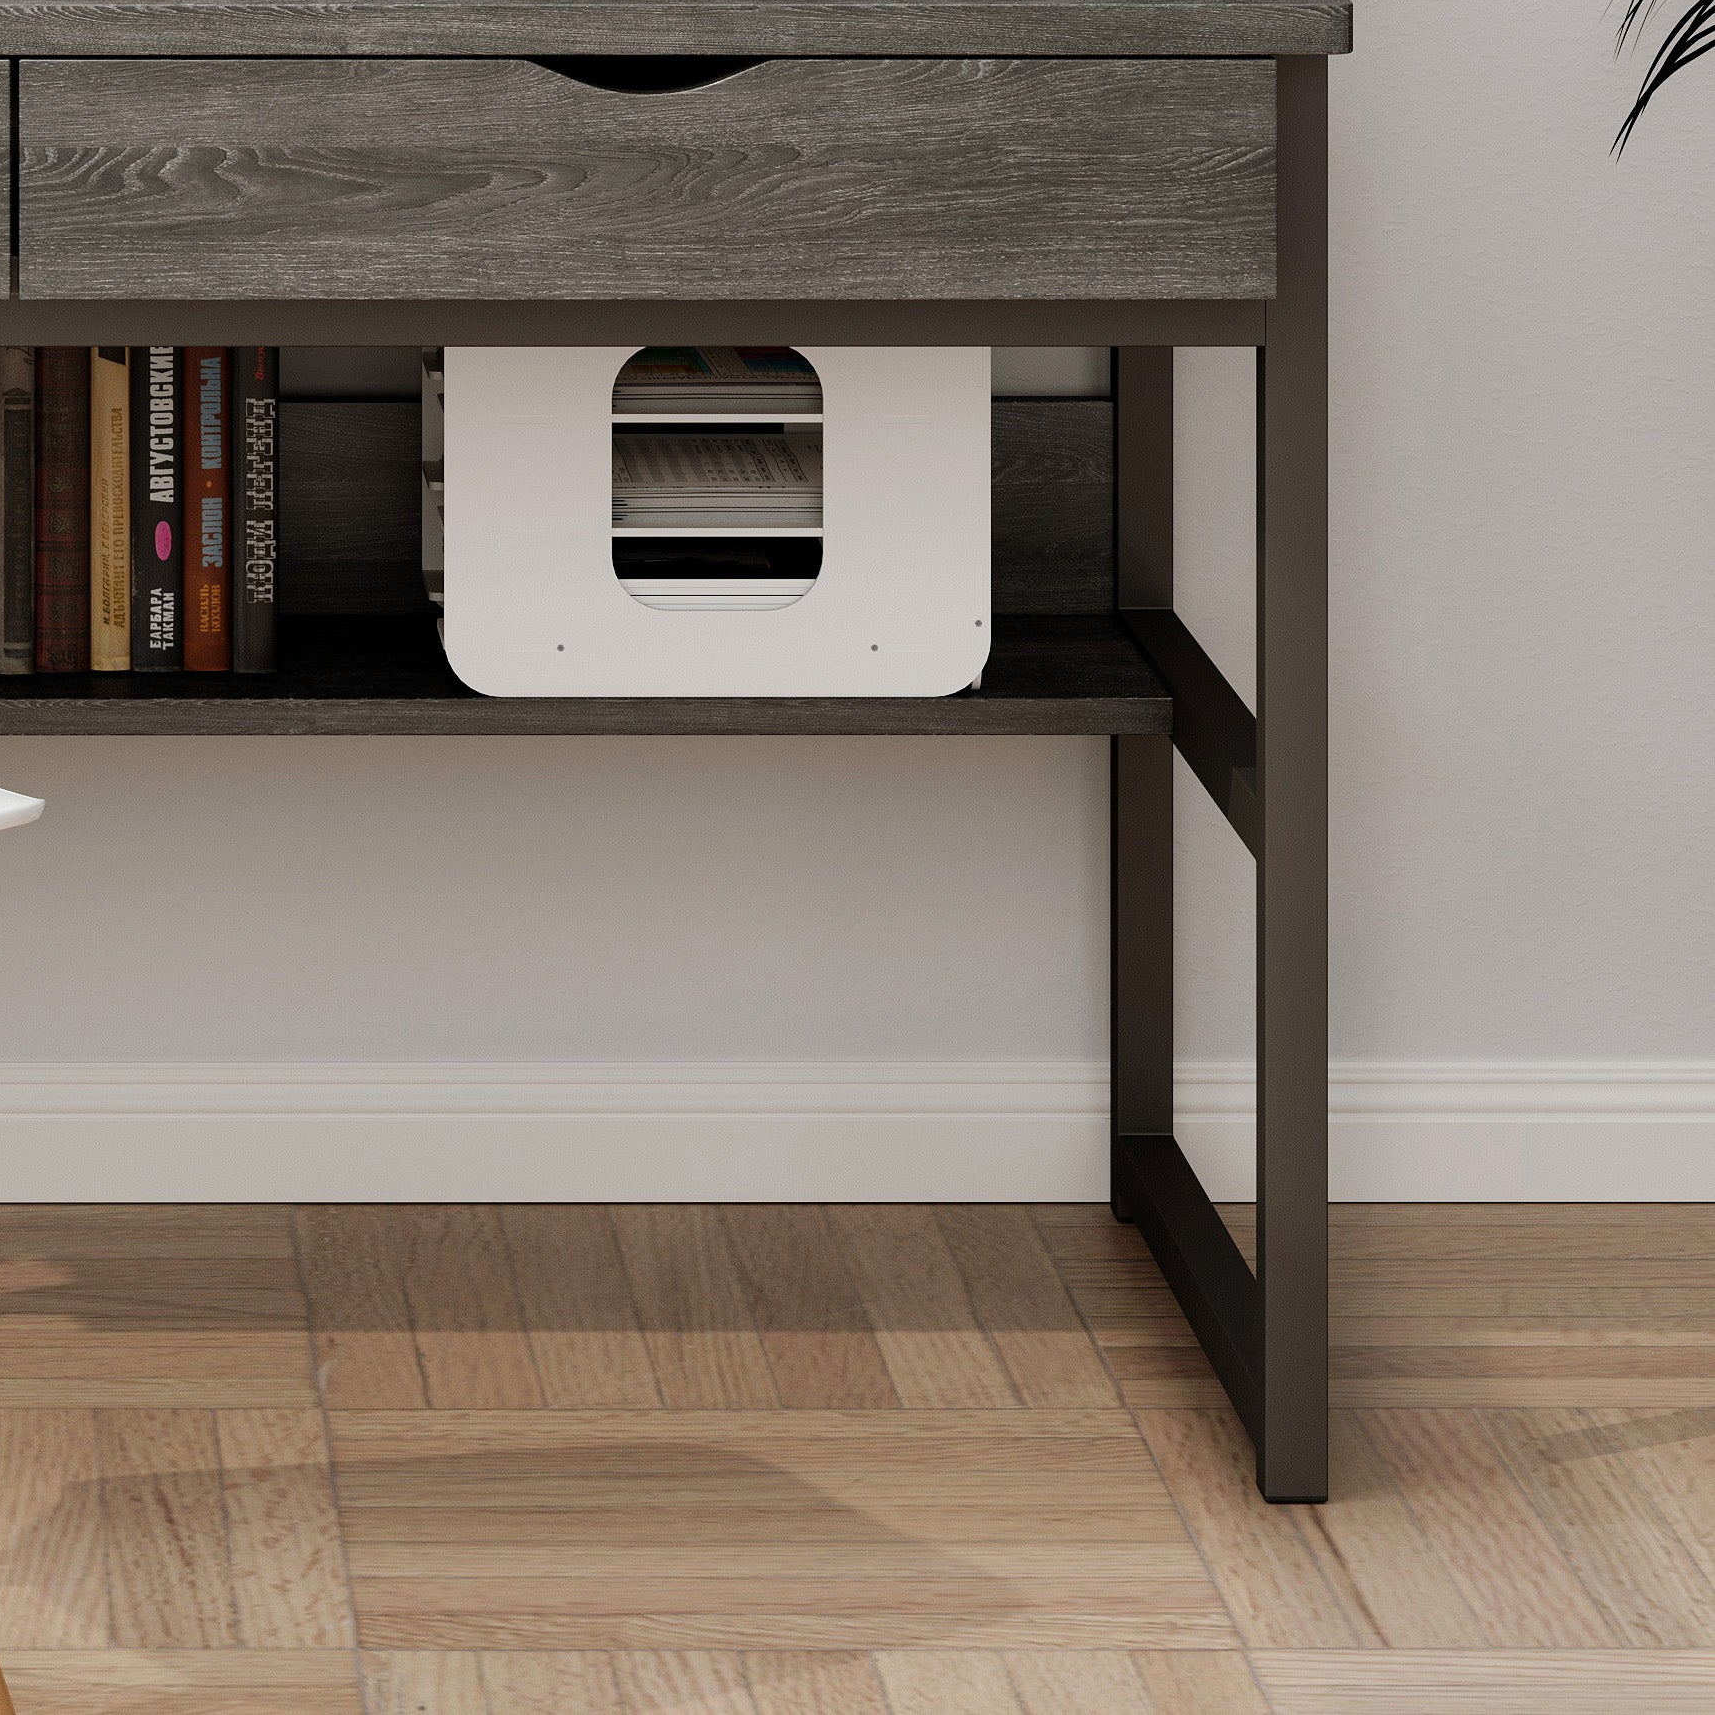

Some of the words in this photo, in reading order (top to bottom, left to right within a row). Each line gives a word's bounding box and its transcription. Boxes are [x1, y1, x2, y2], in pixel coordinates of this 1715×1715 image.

[199, 356, 223, 470] КОНТРОЛЬНА
[244, 397, 277, 511] ЛЕГЕНД
[201, 497, 224, 568] ЗАСЛОН
[149, 587, 163, 649] БАРБАРА
[162, 591, 175, 651] ТАКМАН
